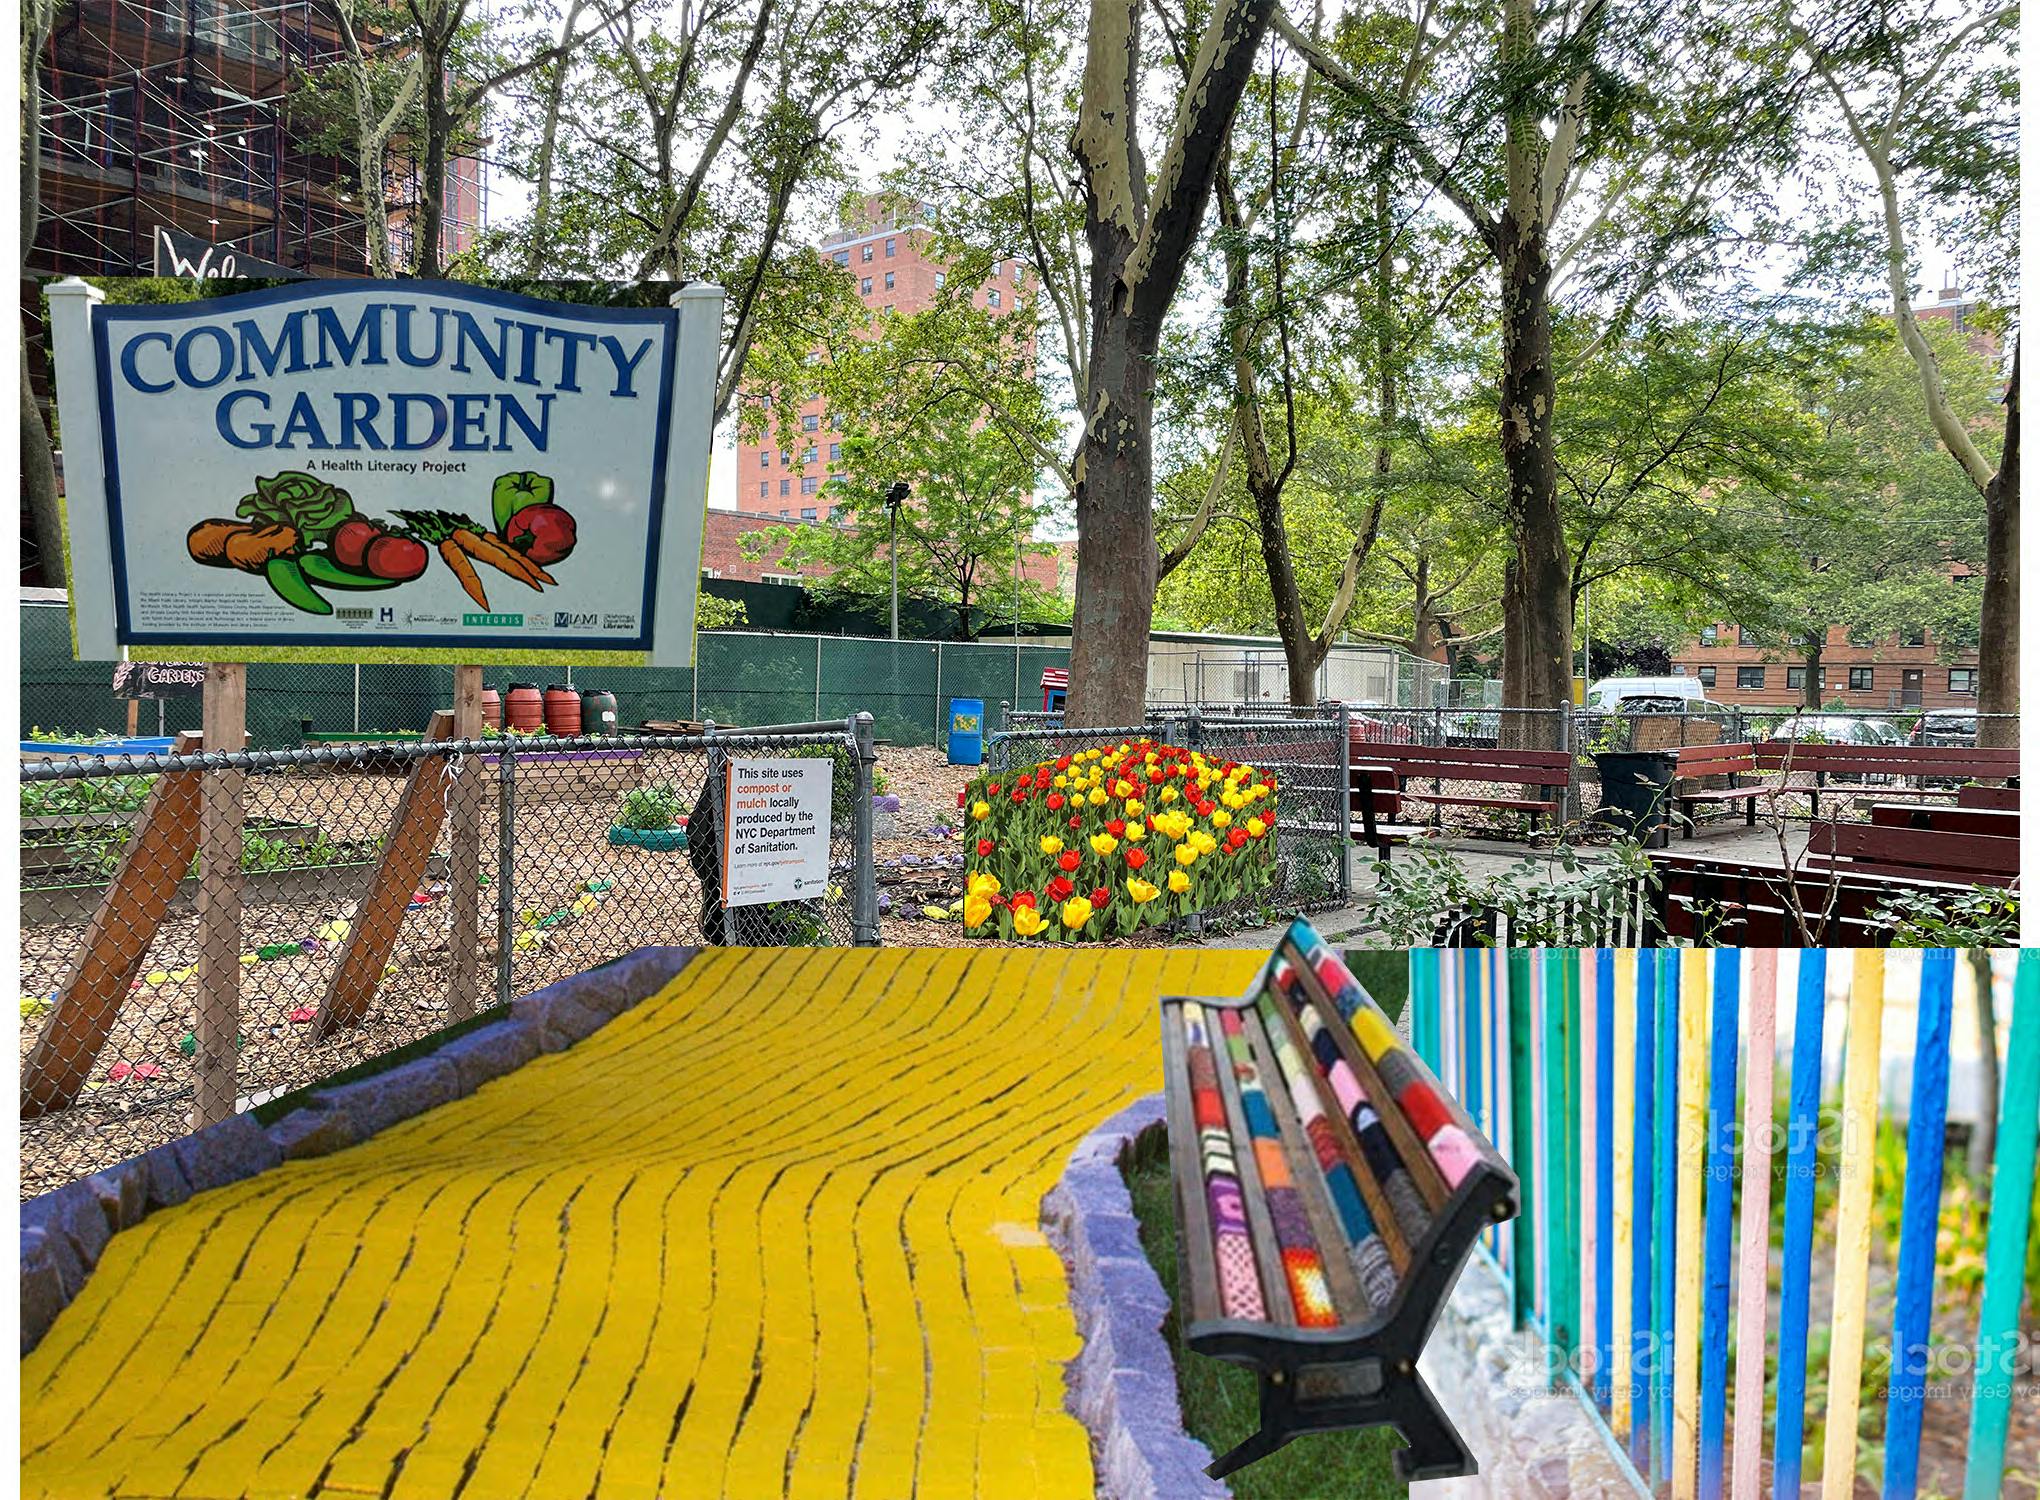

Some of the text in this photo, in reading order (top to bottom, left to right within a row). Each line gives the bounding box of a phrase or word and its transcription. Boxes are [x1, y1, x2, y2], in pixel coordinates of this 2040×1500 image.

[120, 303, 654, 398] COMMUNITY
[214, 389, 557, 453] GARDEN
[306, 460, 467, 475] A Health Literacy Project
[465, 615, 521, 625] INTEGRIS
[555, 612, 598, 625] MIAMI
[148, 667, 205, 687] GARDENS
[738, 768, 804, 779] This site uses
[737, 783, 792, 795] compost or
[737, 797, 799, 809] mulch locally
[736, 811, 813, 826] produced by the
[736, 825, 816, 839] NYC Department
[735, 841, 798, 854] of Sanitation.
